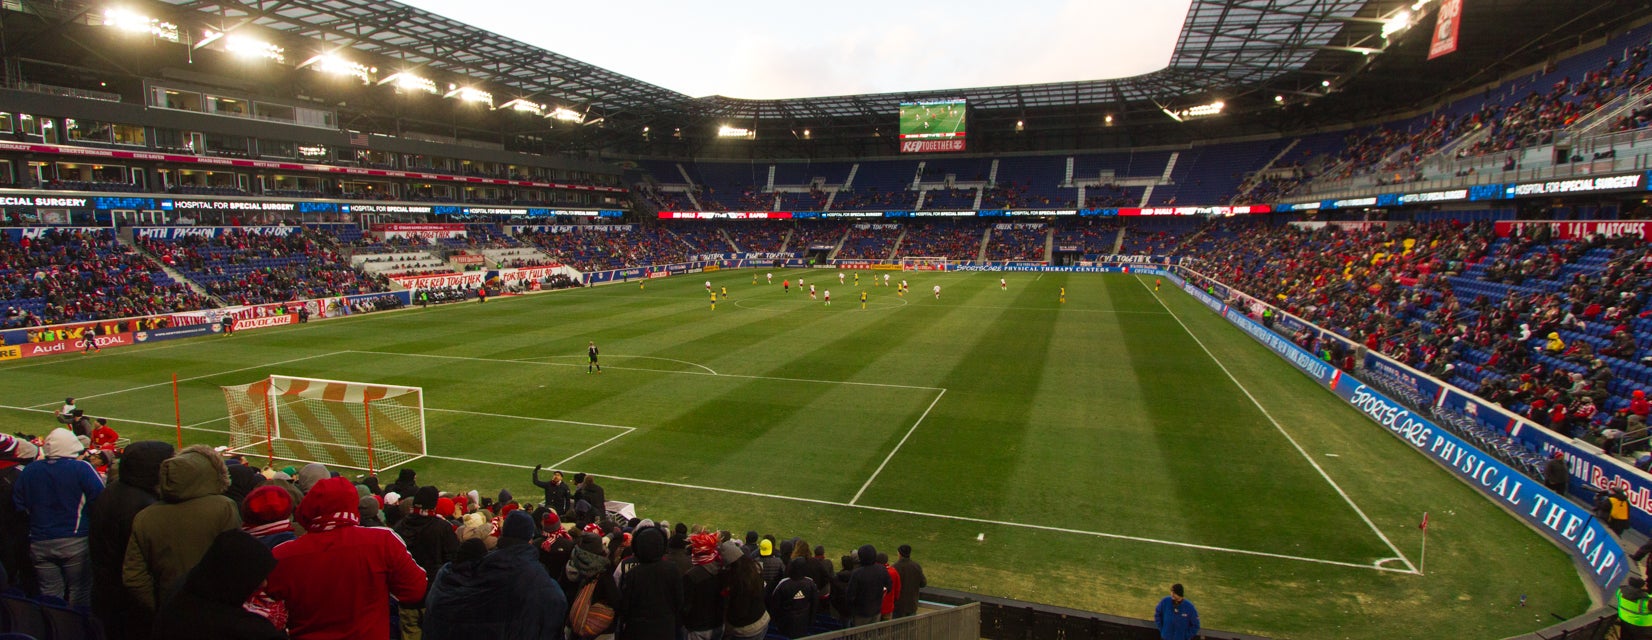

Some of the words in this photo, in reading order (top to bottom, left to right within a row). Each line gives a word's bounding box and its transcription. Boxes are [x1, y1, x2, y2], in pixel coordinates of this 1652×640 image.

[1515, 183, 1545, 195] HOSPITAL
[1545, 182, 1560, 193] FOR
[1560, 178, 1594, 192] SPECIAL
[1595, 174, 1641, 189] SURGERY
[35, 197, 87, 207] SURGERY
[175, 201, 213, 209] HOSPITAL
[229, 202, 261, 210] SPECIAL
[262, 203, 294, 211] SURGERY
[140, 227, 168, 239] WITH
[1568, 222, 1587, 240] 141
[1596, 222, 1645, 240] MATCHES
[402, 279, 415, 290] WE
[415, 278, 428, 288] ARE
[430, 277, 445, 287] RED
[446, 274, 481, 286] TOGETHER
[503, 272, 516, 281] FOR
[529, 269, 543, 279] FULL
[172, 314, 207, 328] VIKING
[233, 314, 292, 331] ADVOCARE
[33, 342, 65, 354] Audi
[1307, 358, 1328, 379] BULLS
[1431, 435, 1522, 505] PHYSICAL
[1529, 493, 1623, 589] THERAPY
